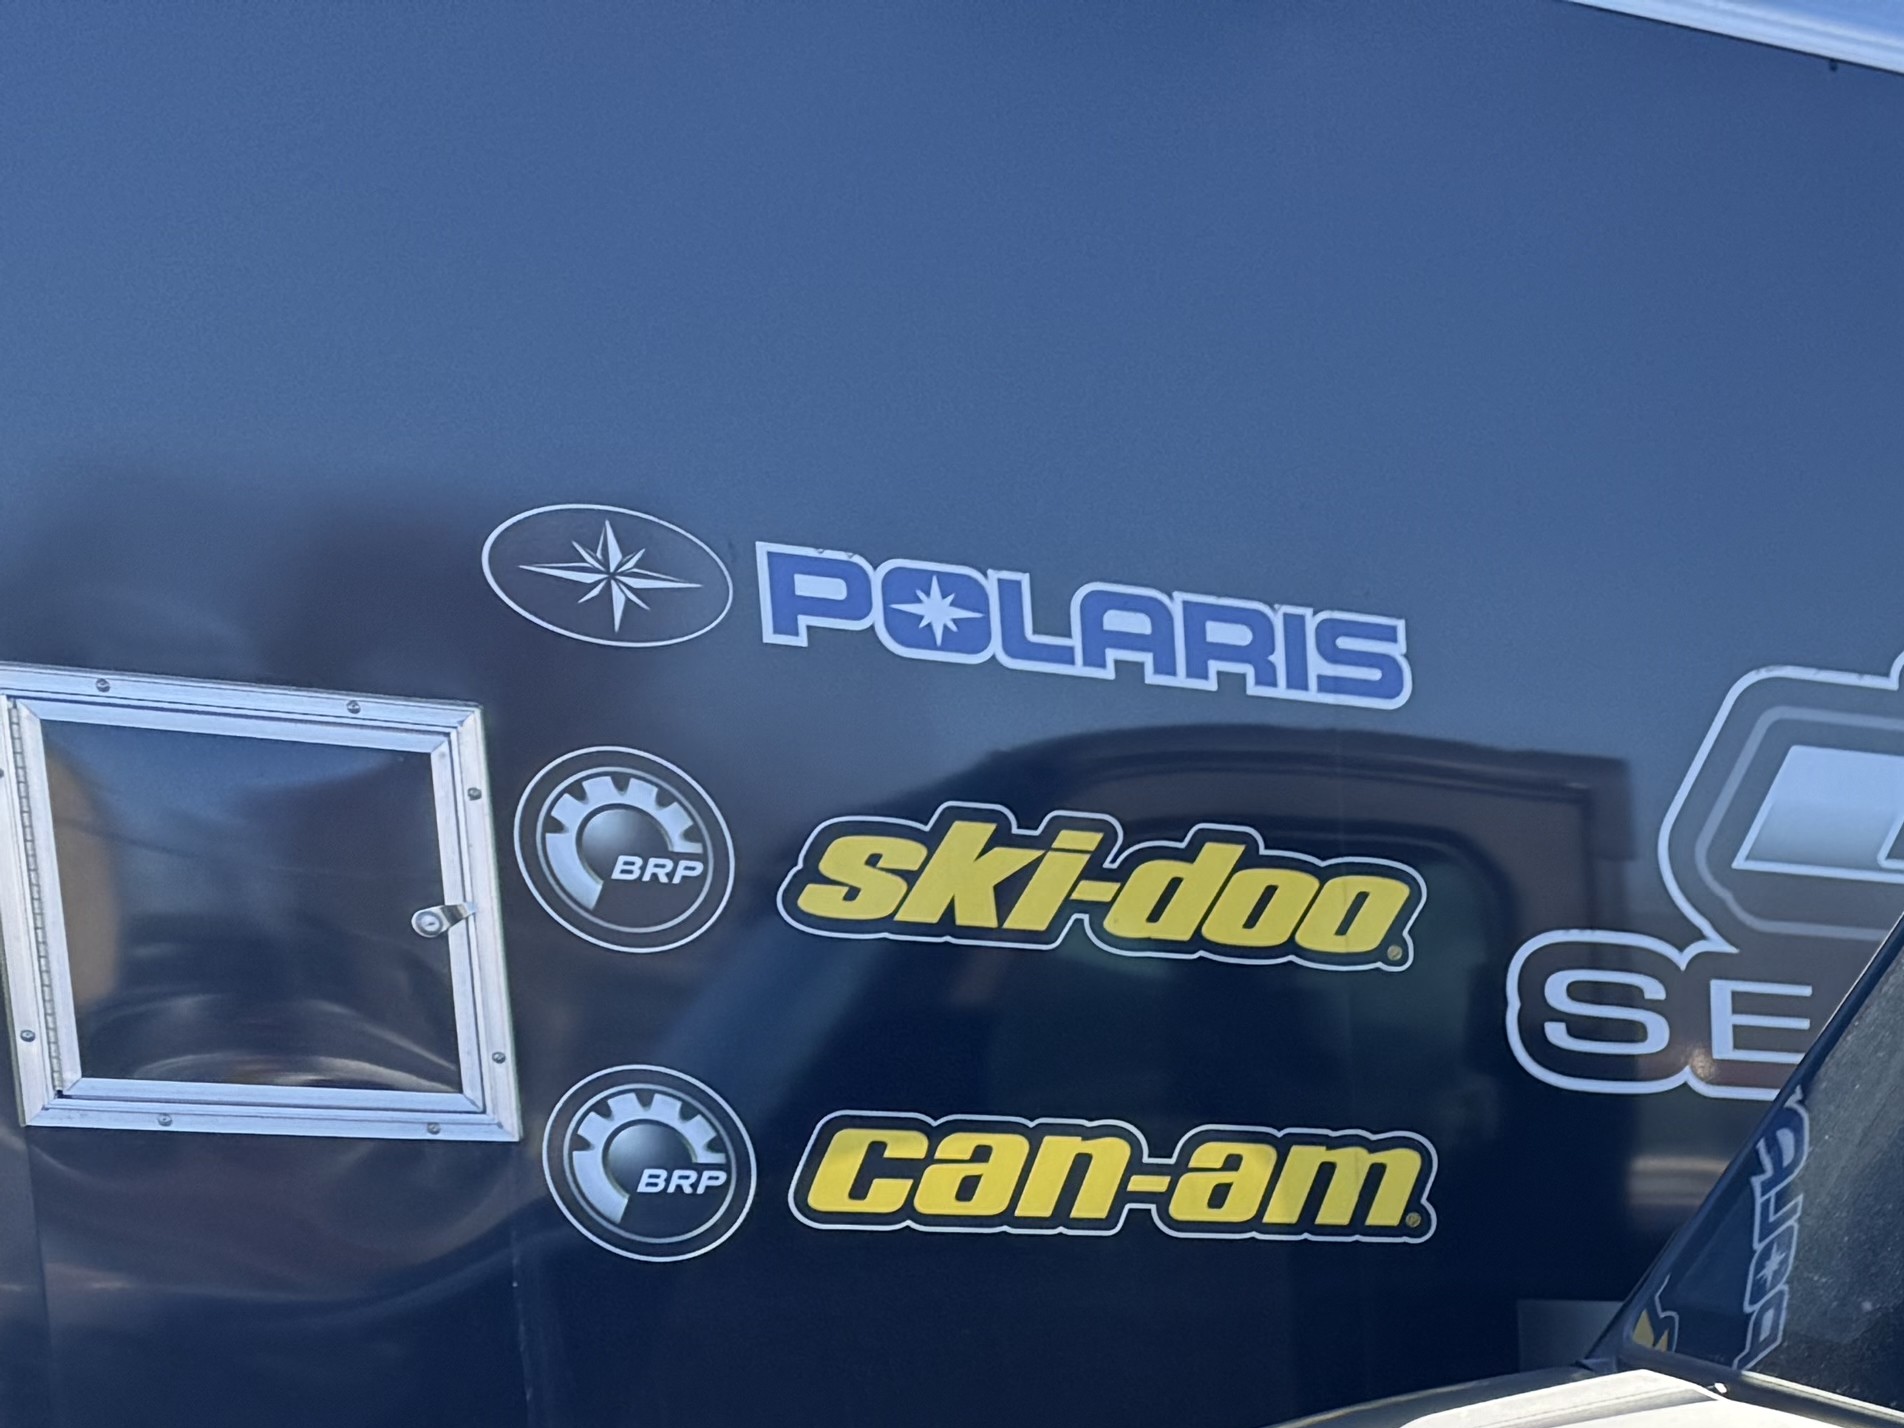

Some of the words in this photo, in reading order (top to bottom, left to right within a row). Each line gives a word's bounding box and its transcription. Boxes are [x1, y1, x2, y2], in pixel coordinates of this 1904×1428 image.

[756, 541, 1413, 708] POLARIS
[611, 855, 704, 884] BRP
[796, 820, 1411, 956] ski-doo
[637, 1170, 728, 1197] BRP
[806, 1128, 1422, 1229] can-am
